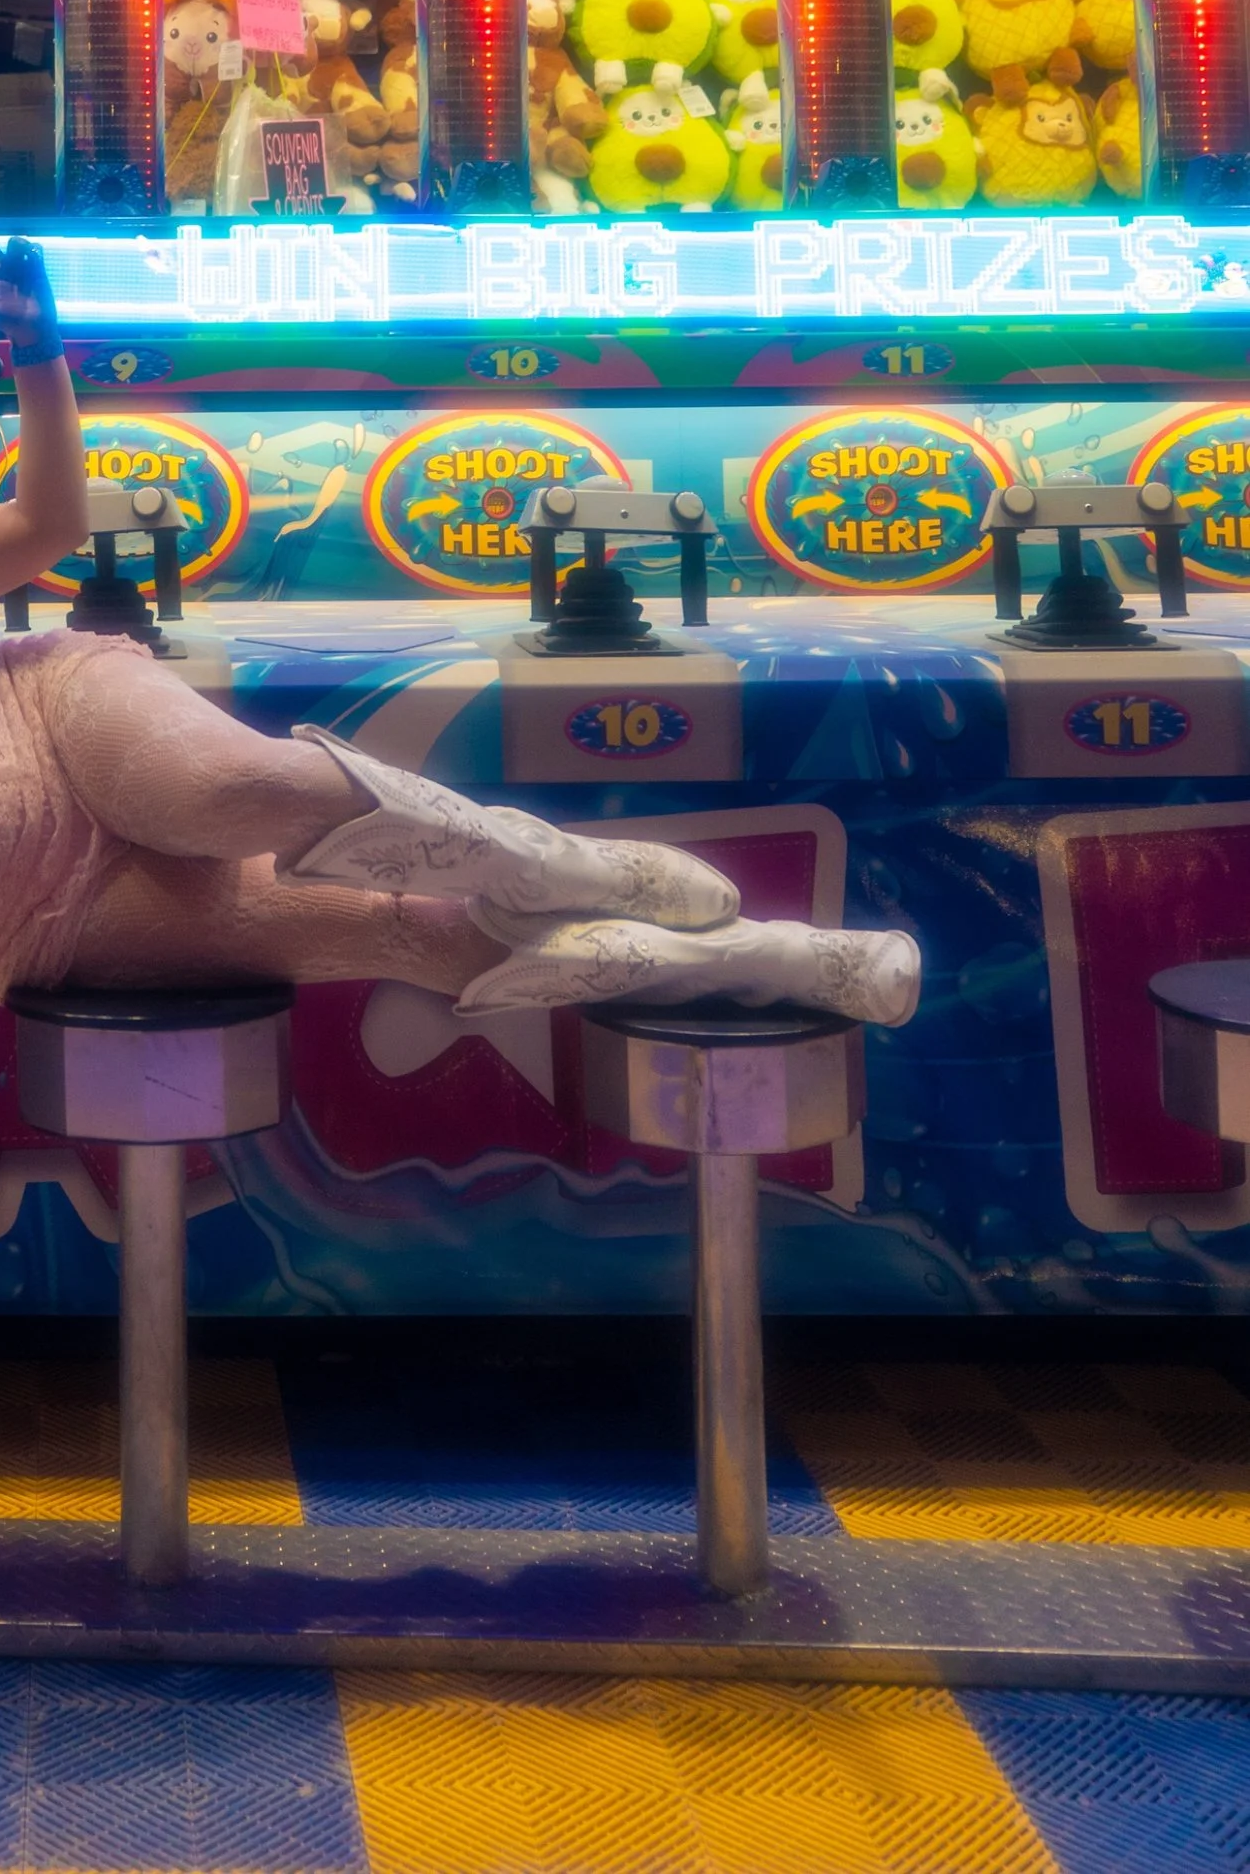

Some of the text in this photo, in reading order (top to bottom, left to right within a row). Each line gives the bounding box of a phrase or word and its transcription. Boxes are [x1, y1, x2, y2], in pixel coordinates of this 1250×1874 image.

[265, 132, 321, 166] SOUVENIR
[285, 164, 309, 195] BAG
[177, 216, 1199, 323] WIN BIG PRIZES
[111, 351, 137, 382] 9
[490, 350, 539, 378] 10
[881, 346, 925, 374] 11
[426, 448, 571, 481] SHOOT
[808, 445, 953, 479] SHOOT
[441, 522, 532, 558] HER
[825, 518, 943, 554] HERE
[596, 704, 660, 747] 10
[1092, 702, 1147, 746] 11
